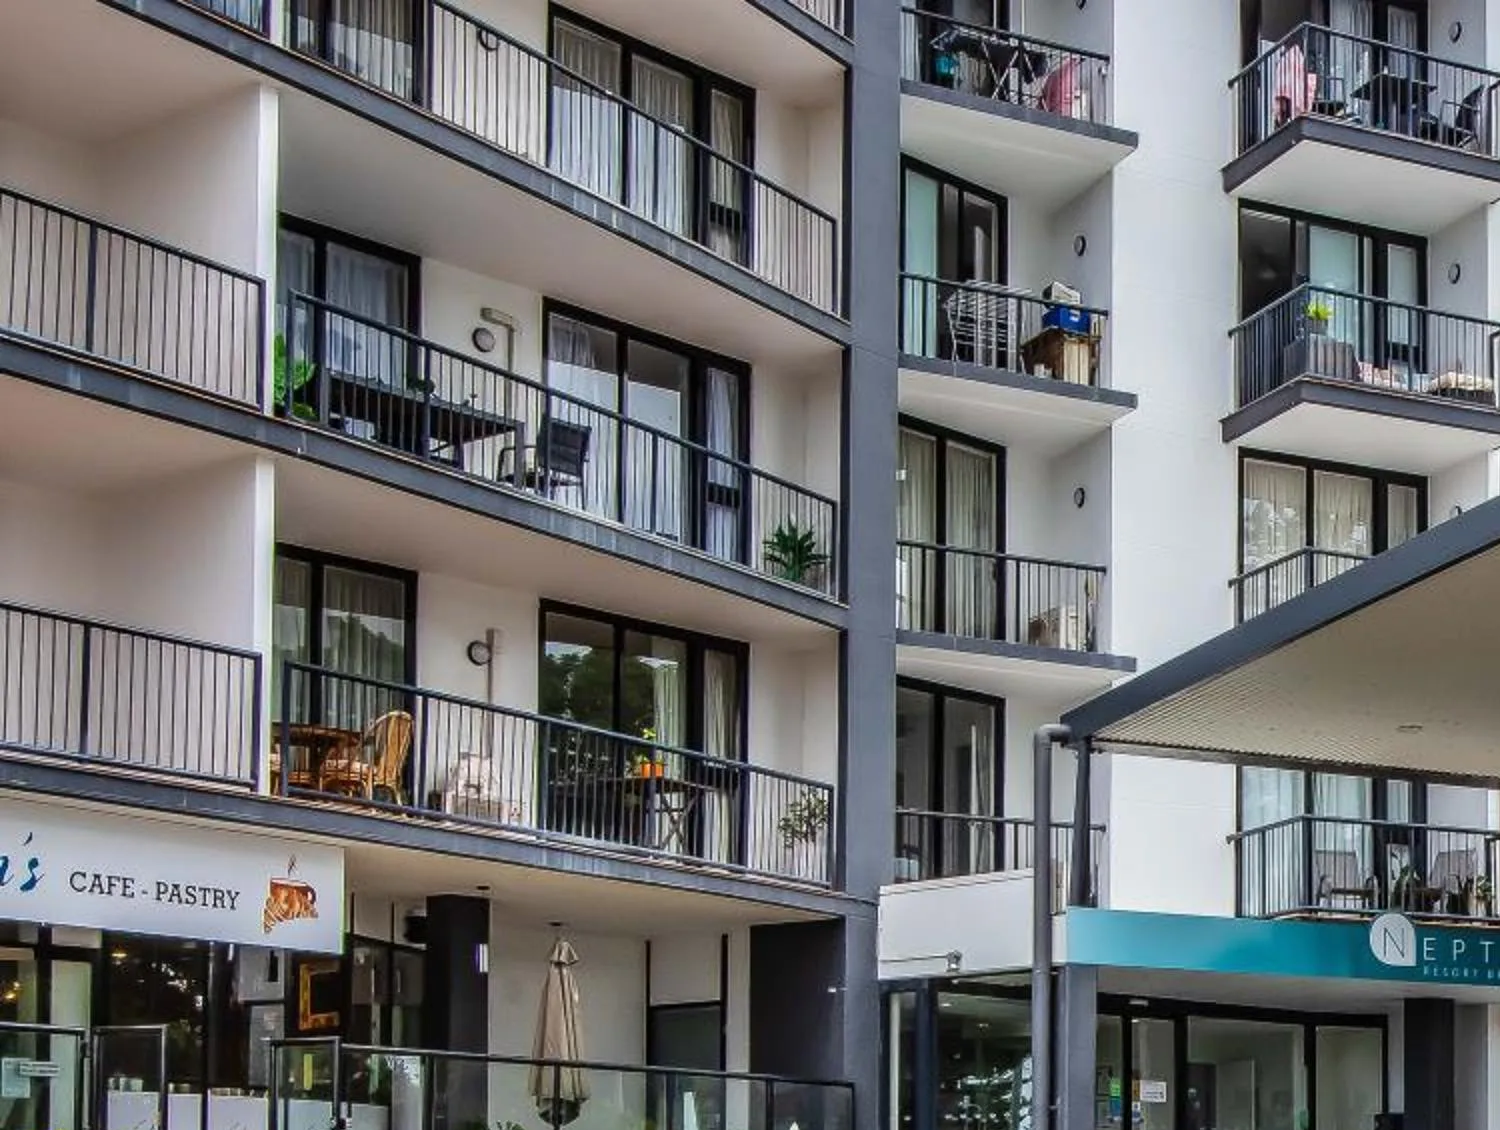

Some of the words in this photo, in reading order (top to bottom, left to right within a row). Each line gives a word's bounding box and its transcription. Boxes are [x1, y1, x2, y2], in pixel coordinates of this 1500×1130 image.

[0, 832, 45, 892] 's
[69, 871, 135, 899] CAFE
[156, 881, 240, 910] PASTRY
[1423, 966, 1479, 979] RESORT
